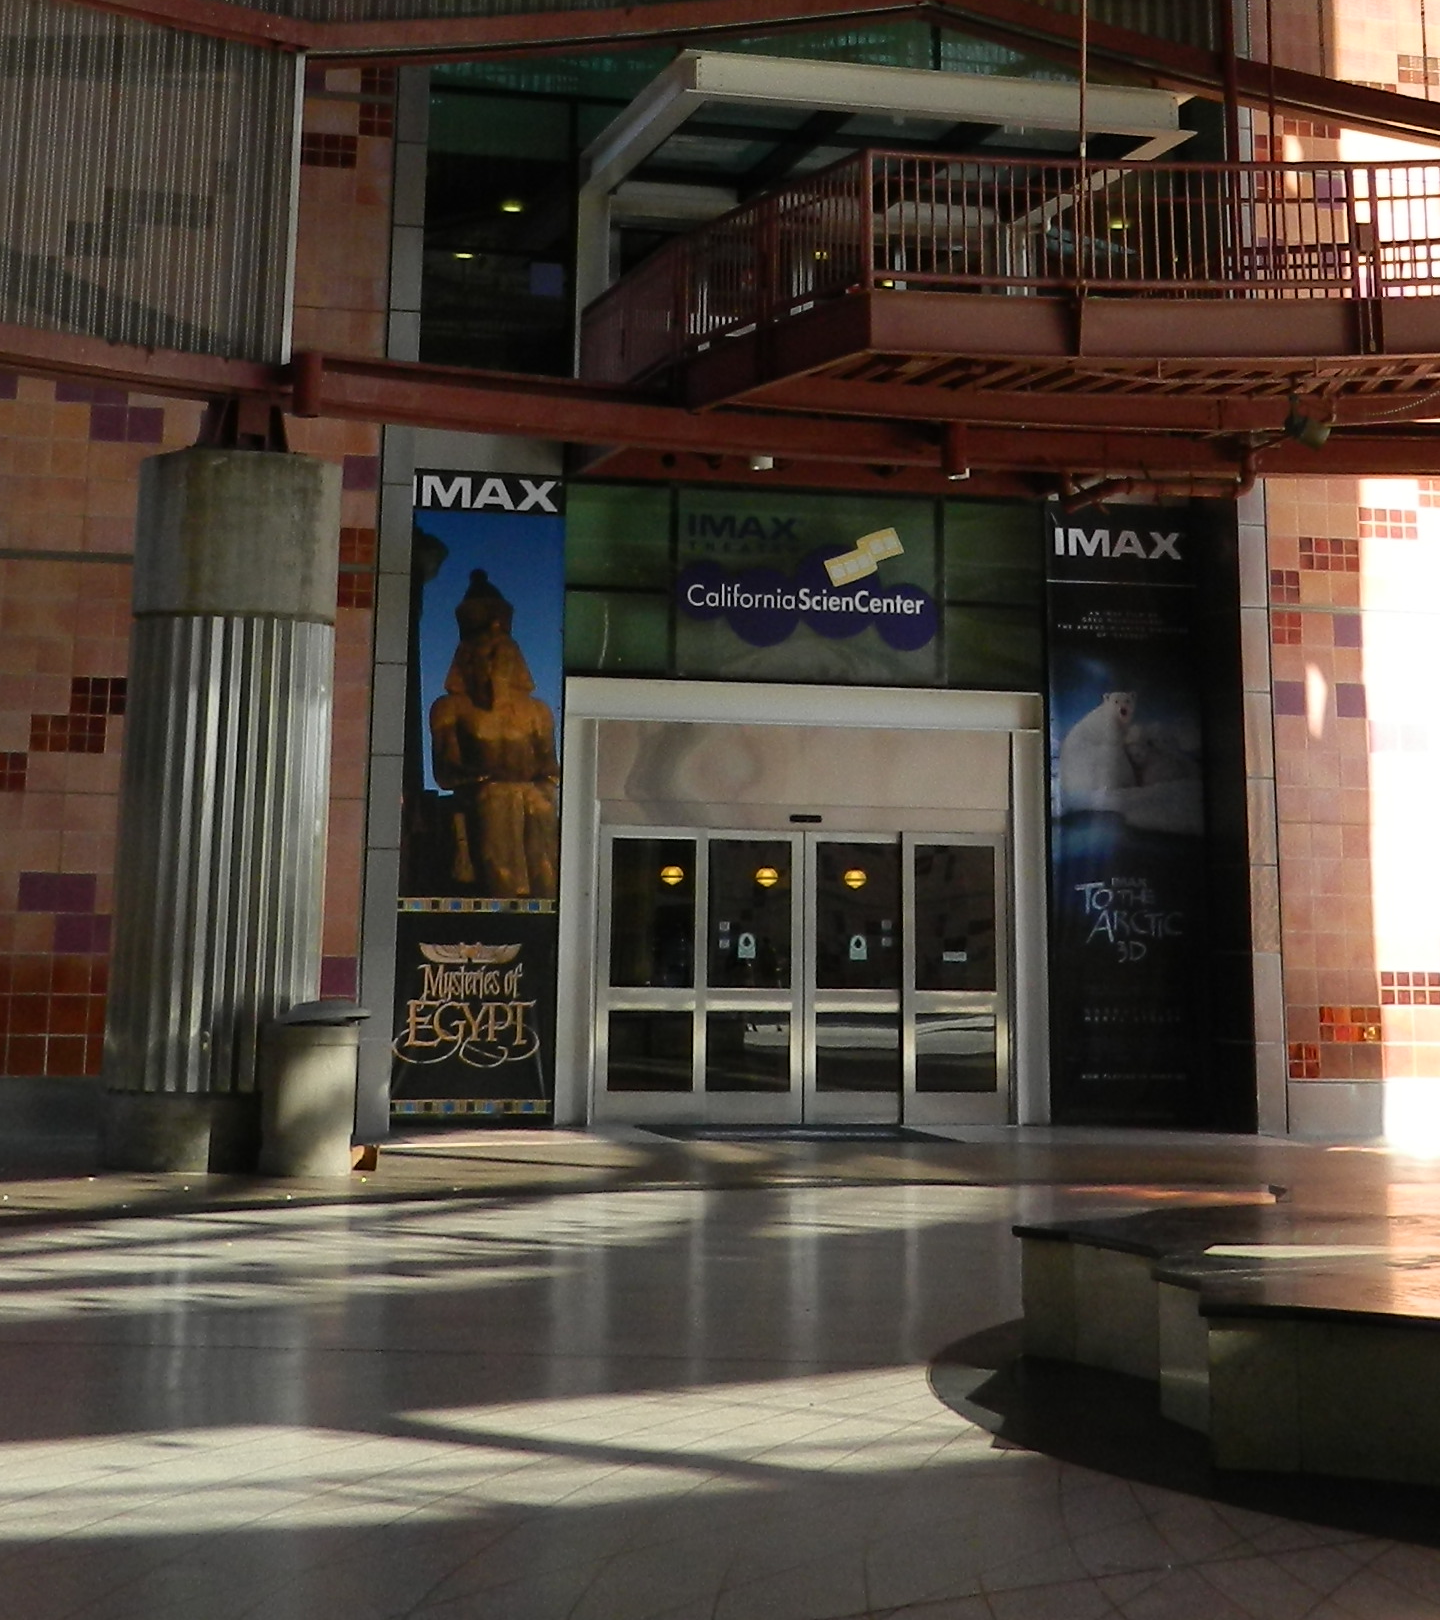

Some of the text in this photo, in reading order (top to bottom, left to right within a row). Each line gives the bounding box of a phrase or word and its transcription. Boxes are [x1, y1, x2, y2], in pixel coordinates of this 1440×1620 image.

[413, 475, 558, 512] IMAX
[688, 513, 799, 541] IMAX
[1054, 527, 1182, 560] IMAX
[1074, 882, 1156, 914] TO THE
[1086, 910, 1184, 943] ARCTIC
[1116, 940, 1148, 963] 3D
[417, 962, 524, 1006] Mysteries of
[396, 998, 539, 1063] EGYPT
